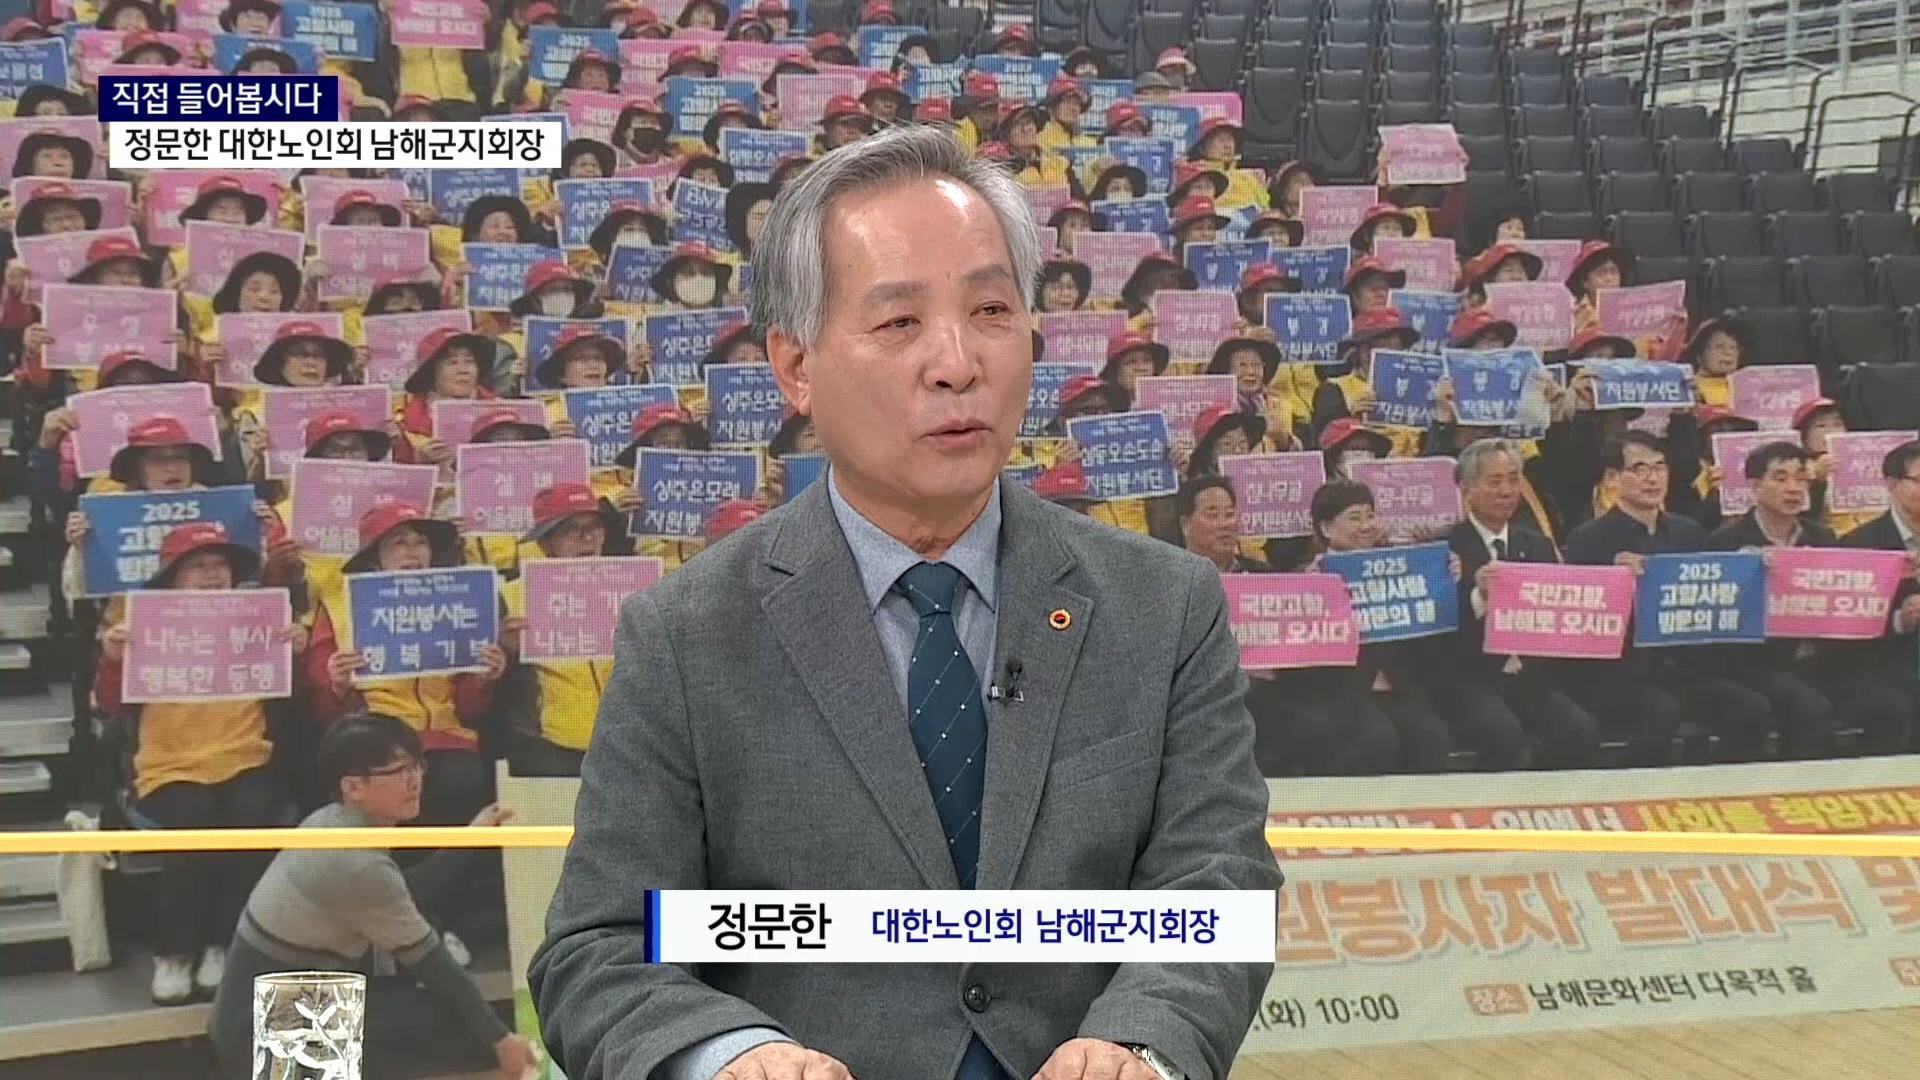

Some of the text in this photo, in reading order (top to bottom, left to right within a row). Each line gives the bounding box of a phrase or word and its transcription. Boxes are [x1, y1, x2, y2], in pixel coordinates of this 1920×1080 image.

[141, 502, 201, 521] 2025
[644, 509, 702, 535] 자원봉
[1361, 558, 1407, 578] 2025
[1678, 562, 1723, 581] 2025
[1792, 568, 1877, 592] 국민고향,
[546, 591, 588, 619] 주는
[1238, 592, 1332, 618] 국민고향,
[1519, 581, 1607, 610] 국민고향,
[1659, 581, 1739, 608] 고향사랑
[1832, 596, 1891, 619] 오시다
[370, 600, 480, 636] 자원봉사는
[1493, 608, 1624, 637] 남해로 오시다
[1658, 608, 1740, 634] 방문의 해
[143, 624, 216, 657] 나누는
[533, 626, 598, 654] 나누는
[1285, 621, 1350, 645] 오시다
[1585, 858, 1862, 942] 발대식
[1529, 965, 1818, 1010] 남해문화센터 다목적 홀
[1316, 993, 1401, 1026] 10:00
